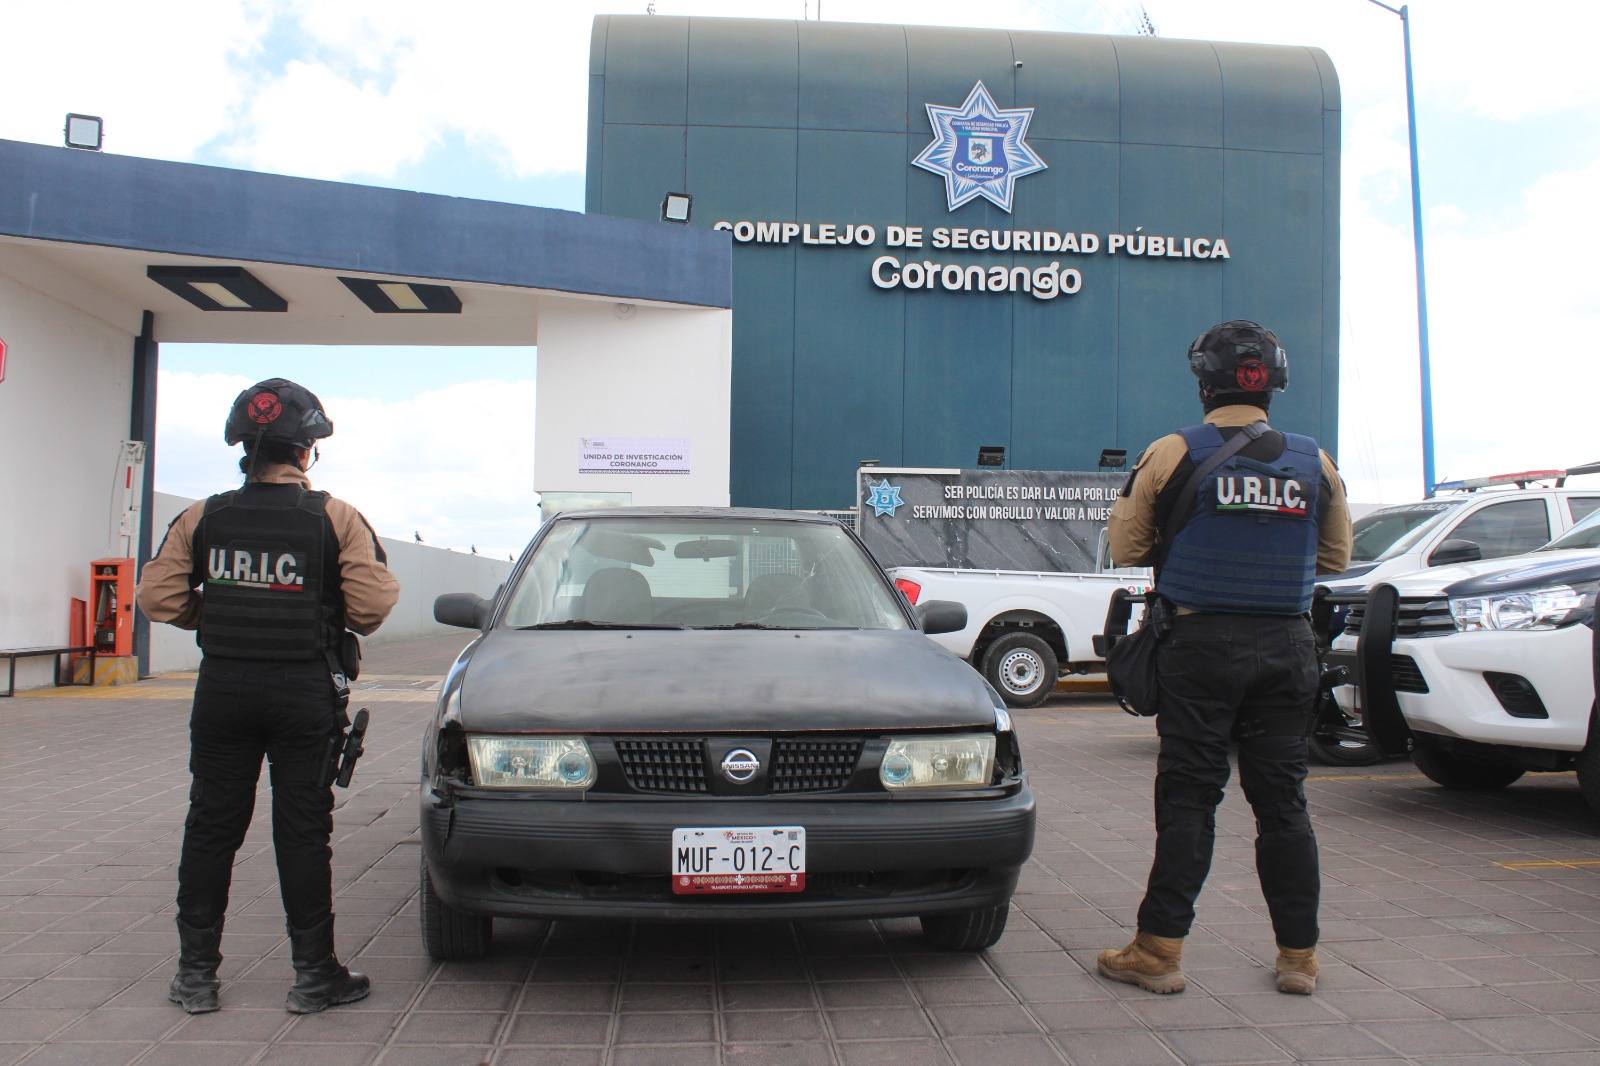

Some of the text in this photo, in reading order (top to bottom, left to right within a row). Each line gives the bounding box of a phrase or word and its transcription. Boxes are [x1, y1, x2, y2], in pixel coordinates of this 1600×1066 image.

[956, 162, 1004, 175] Coronango
[886, 226, 923, 247] DE
[932, 228, 1099, 253] SEGURIDAD
[1108, 226, 1230, 258] PÚBLICA
[871, 256, 1081, 299] Coronango
[944, 485, 964, 499] SER
[966, 483, 1004, 499] POLICÍA
[1006, 487, 1019, 500] ES
[1021, 487, 1041, 500] DAR
[1043, 487, 1056, 500] LA
[1058, 487, 1081, 500] VIDA
[1083, 488, 1103, 501] POR
[1217, 477, 1306, 509] U.R.I.C.
[913, 505, 964, 519] SERVIMOS
[966, 506, 987, 519] CON
[989, 506, 1033, 520] ORGULLO
[1035, 506, 1042, 520] Y
[1044, 506, 1076, 520] VALOR
[1077, 507, 1086, 520] A
[208, 548, 304, 585] U.R.I.C.
[678, 845, 800, 873] MUF-012-C
